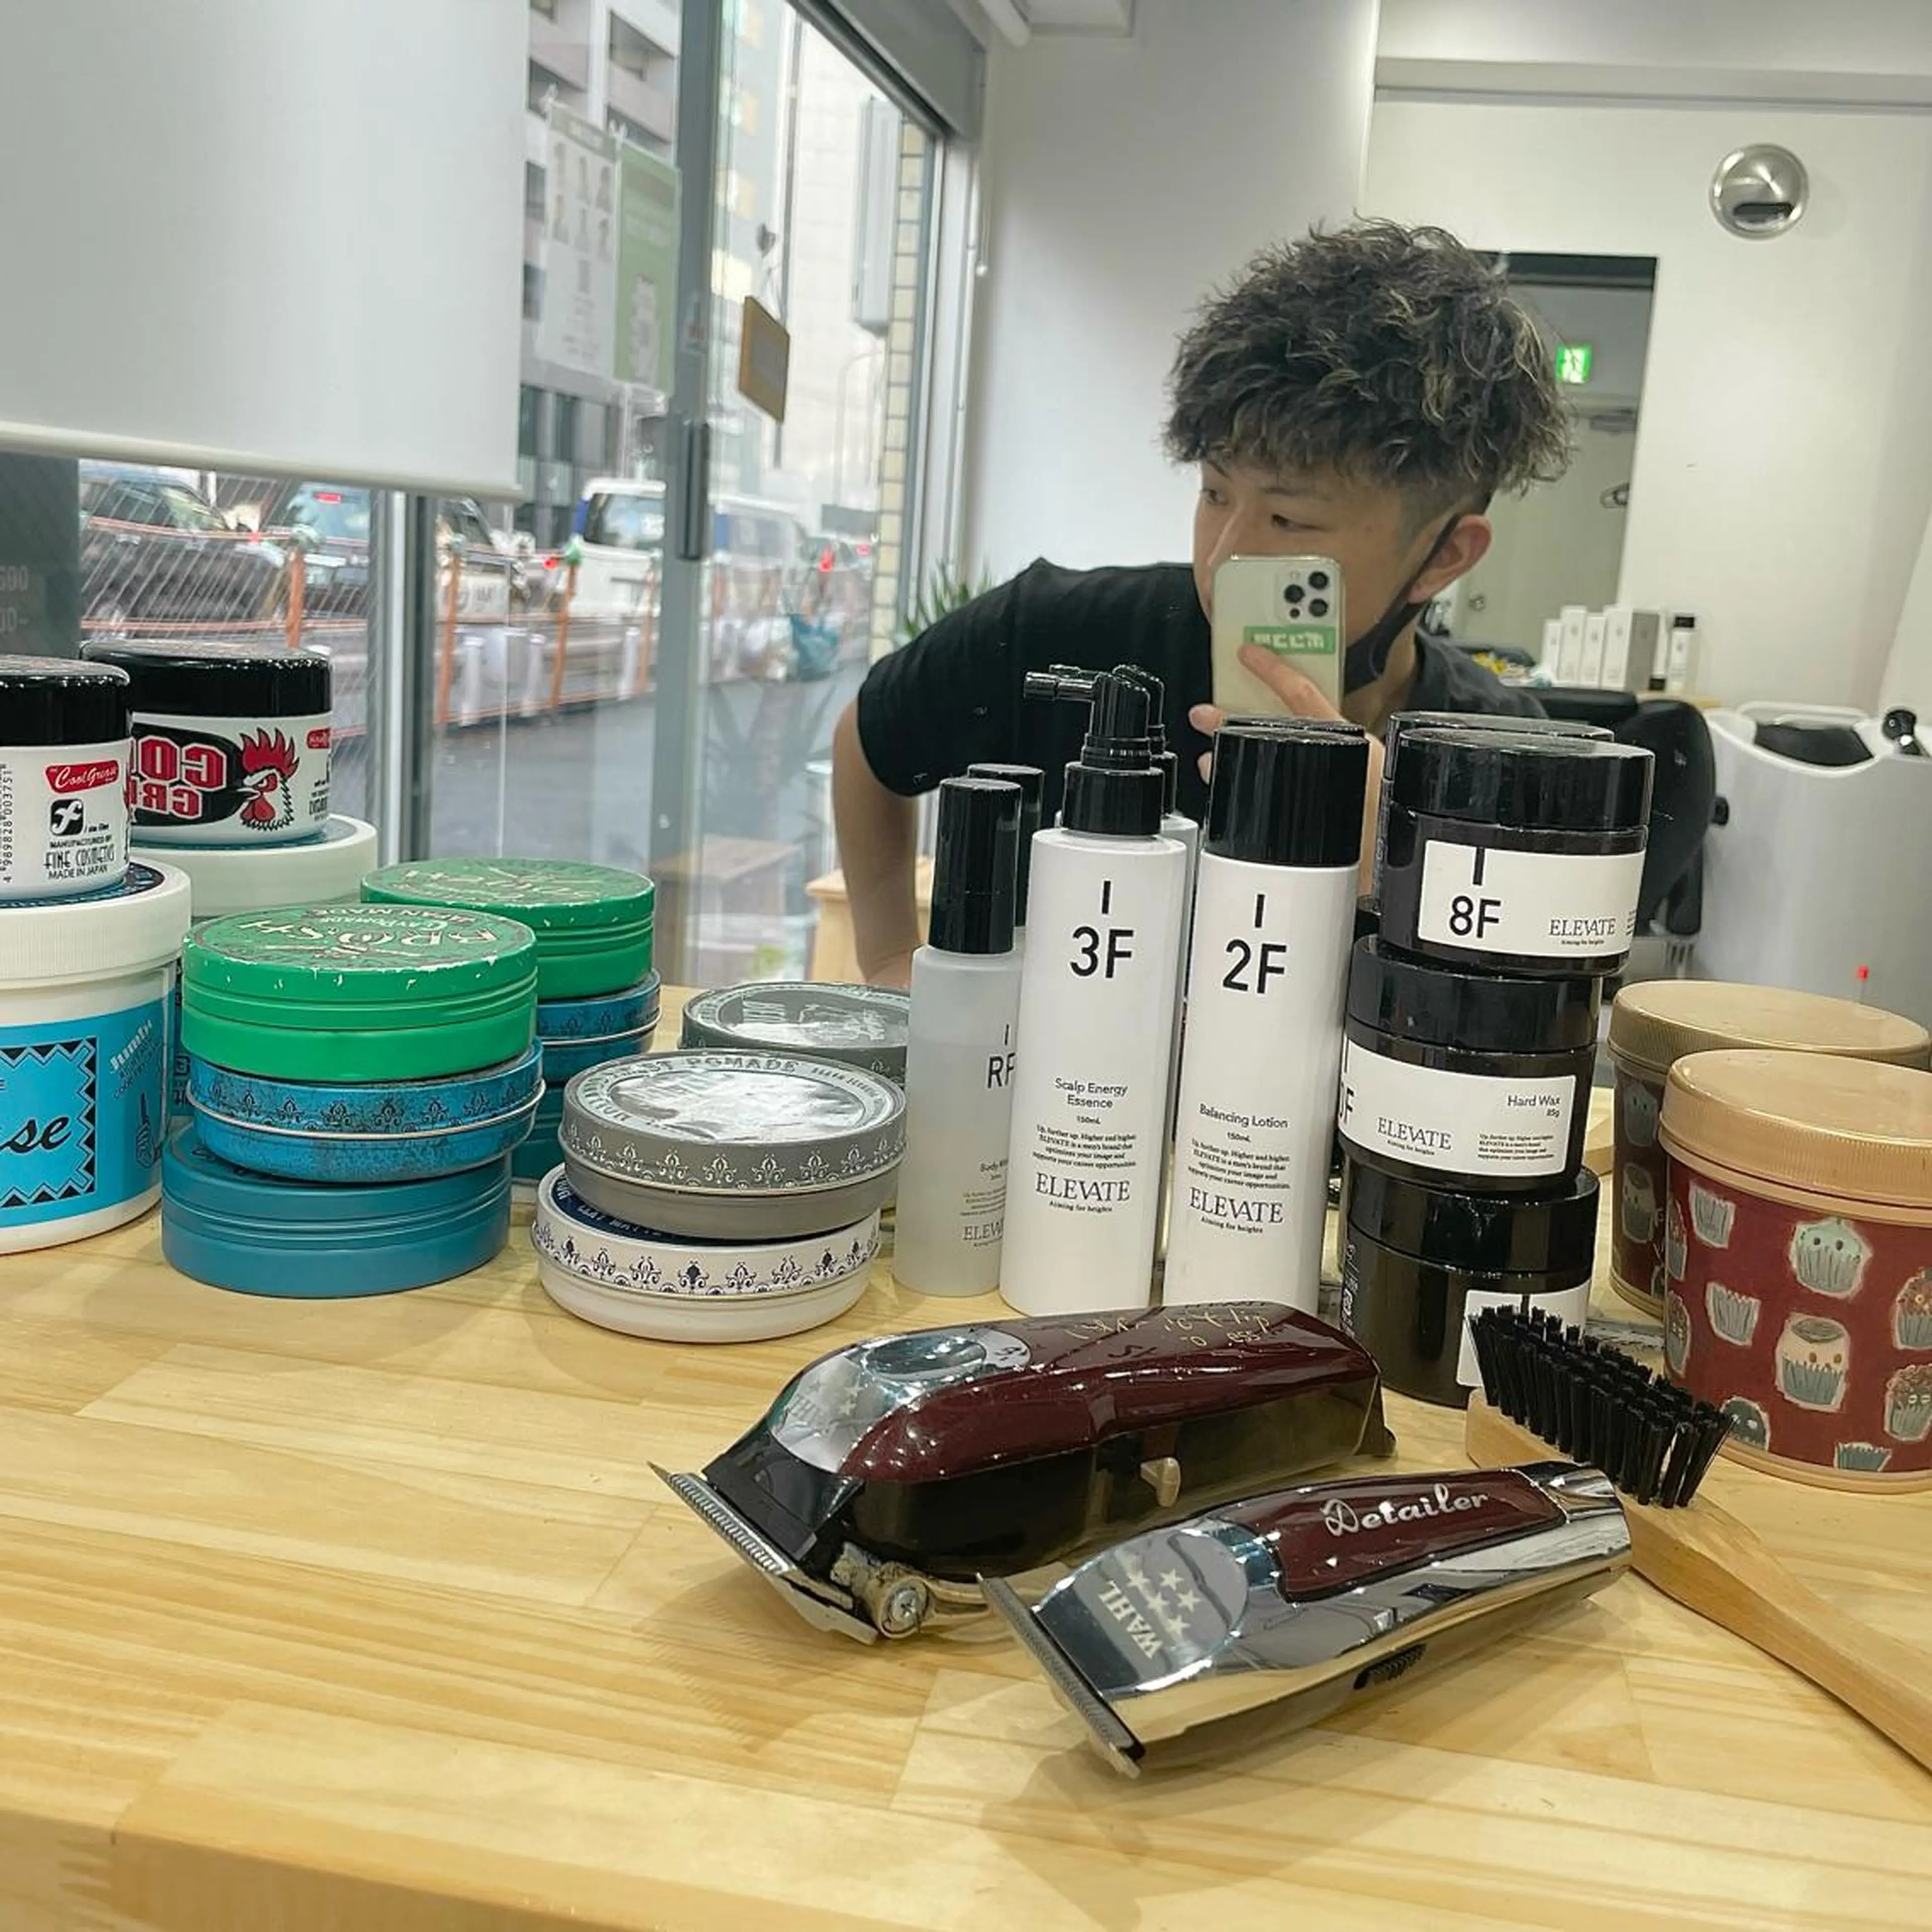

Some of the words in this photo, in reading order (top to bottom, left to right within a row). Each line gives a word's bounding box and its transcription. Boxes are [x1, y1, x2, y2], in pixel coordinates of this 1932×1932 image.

[48, 868, 75, 880] MADE
[1448, 896, 1501, 939] 8F
[1549, 918, 1616, 936] ELEVATE
[1070, 926, 1135, 979] 3F
[1222, 938, 1287, 994] 2F
[1055, 1078, 1086, 1094] Scalp
[1088, 1082, 1128, 1097] Energy
[1068, 1094, 1113, 1108] Essence
[1507, 1095, 1537, 1106] Hard
[1198, 1102, 1249, 1129] Balancing
[1252, 1115, 1289, 1129] Lotion
[0, 1114, 72, 1155] se
[1378, 1116, 1452, 1150] ELEVATE
[1035, 1172, 1131, 1201] ELEVATE
[1189, 1186, 1284, 1223] ELEVATE
[1319, 1483, 1489, 1537] Detailer
[1098, 1579, 1163, 1660] WAHL
